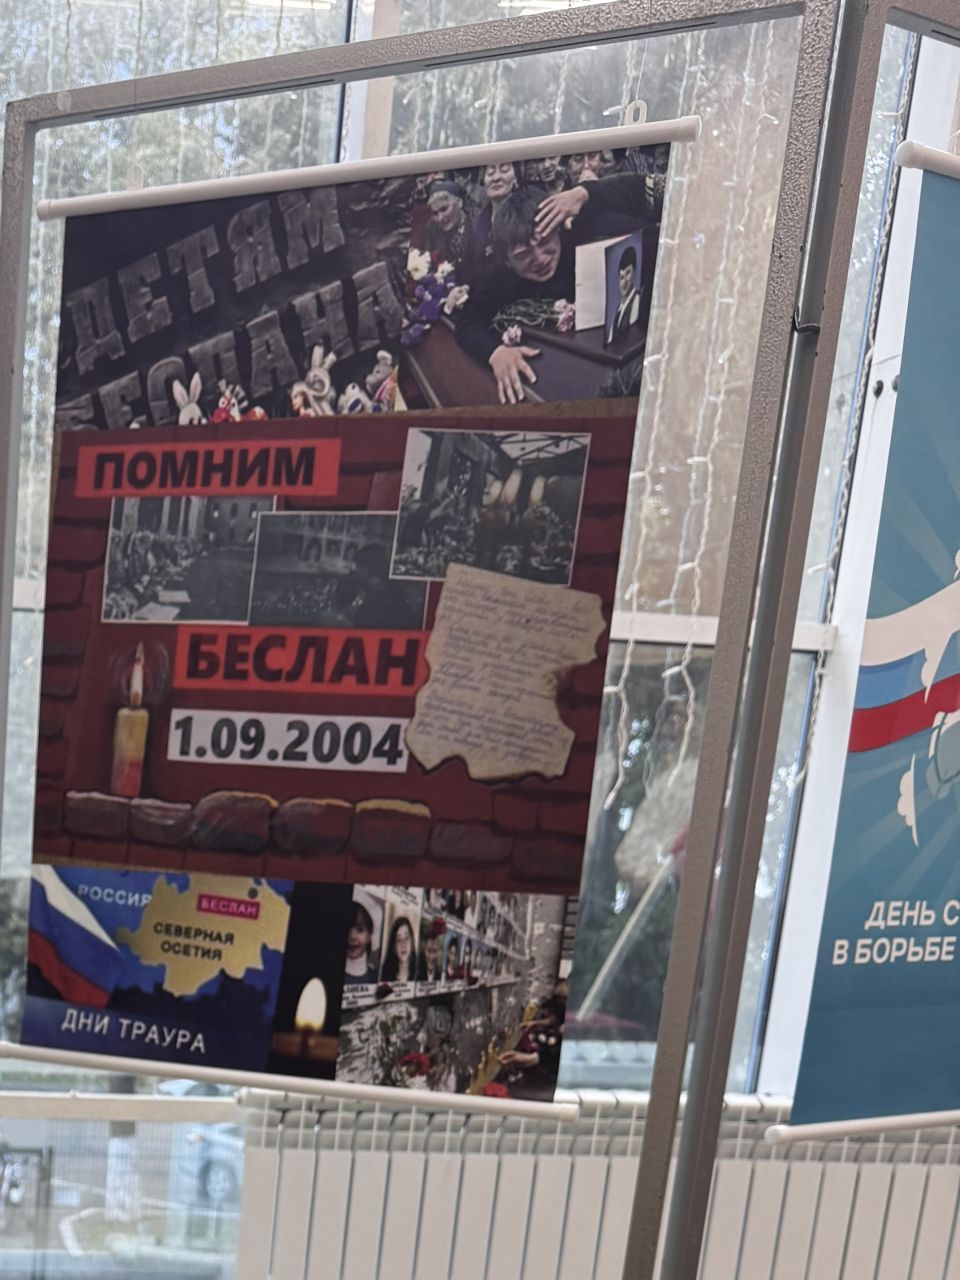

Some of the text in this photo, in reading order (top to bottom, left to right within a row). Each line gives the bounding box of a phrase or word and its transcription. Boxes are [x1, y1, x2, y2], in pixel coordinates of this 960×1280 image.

[65, 185, 345, 376] ДЕТЯМ
[93, 446, 318, 490] ПОМНИМ
[186, 633, 421, 687] БЕСЛАН
[174, 716, 404, 765] 1.09.2004
[77, 884, 152, 907] РОССИЯ
[200, 897, 258, 916] БЕСЛАН
[864, 901, 936, 930] ДЕНЬ
[153, 921, 235, 945] СЕВЕРНАЯ
[160, 941, 223, 961] ОСЕТИЯ
[832, 936, 957, 965] В БОРЬБЕ
[61, 1008, 206, 1053] ДНИ ТРАУРА
